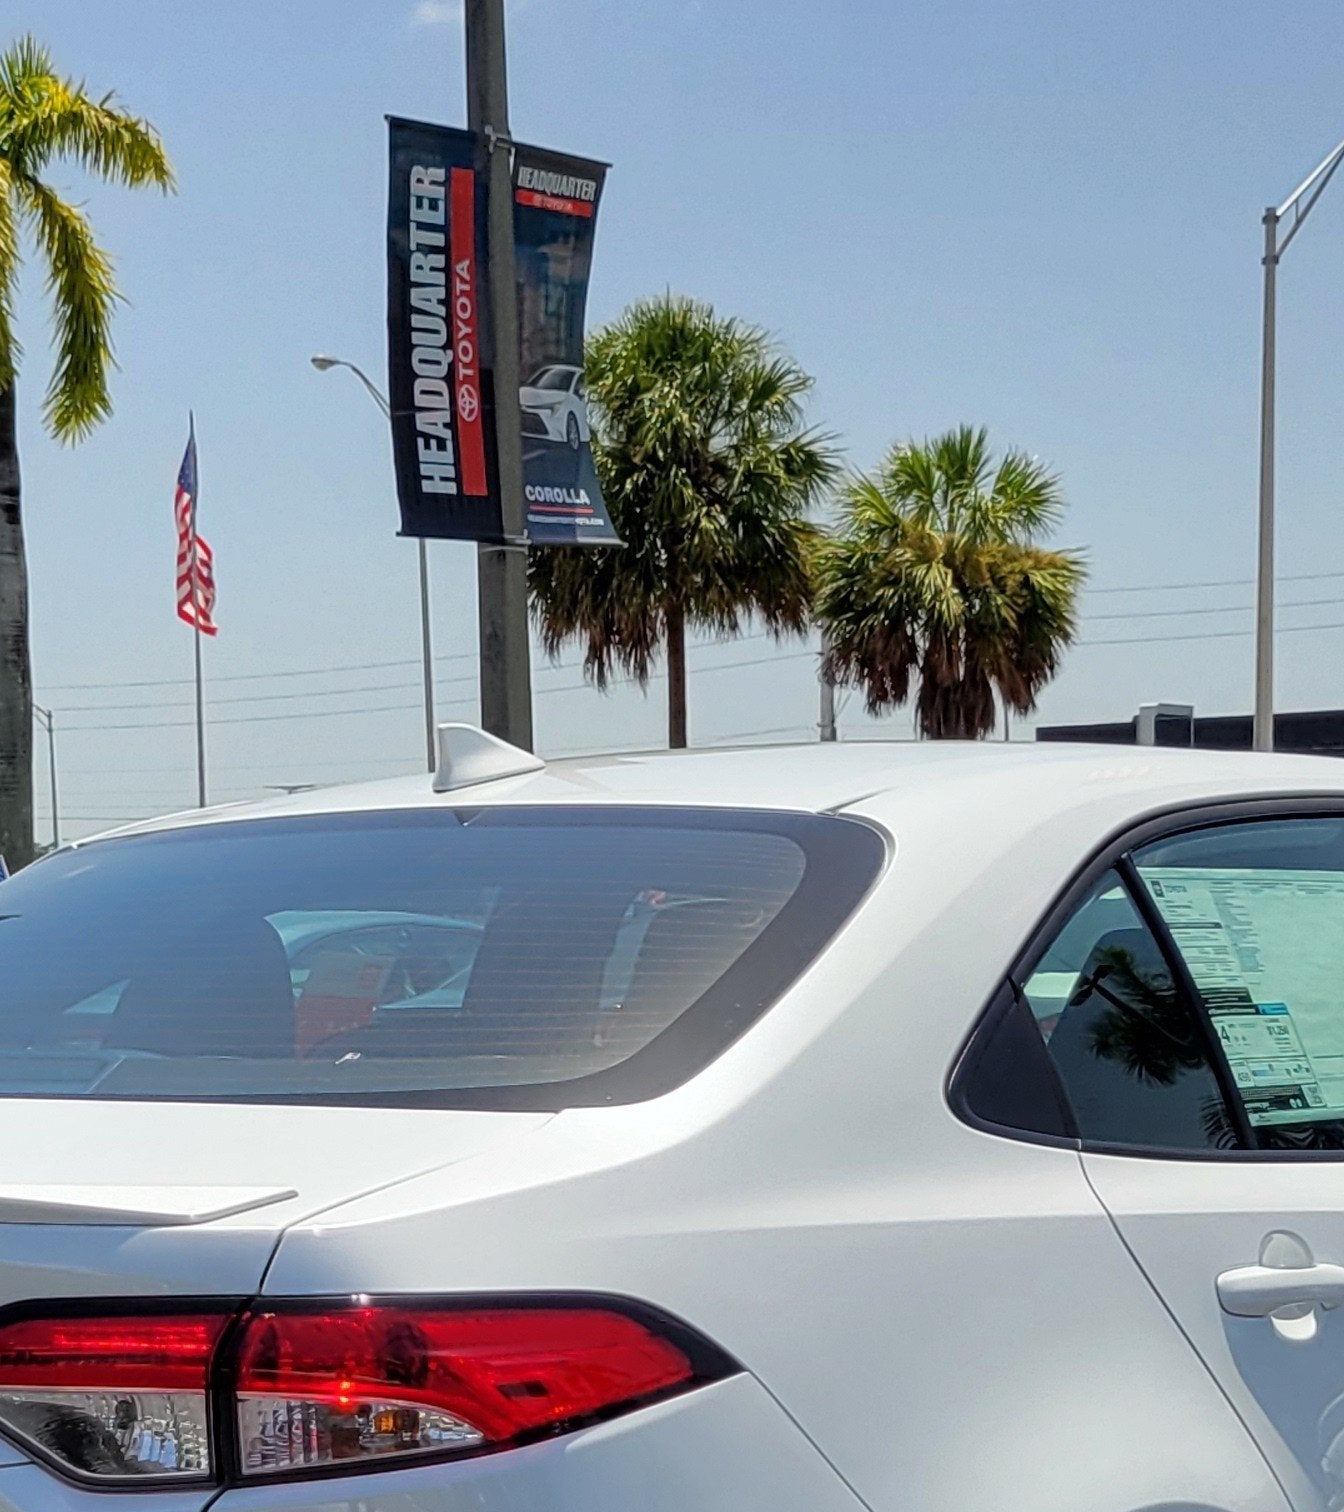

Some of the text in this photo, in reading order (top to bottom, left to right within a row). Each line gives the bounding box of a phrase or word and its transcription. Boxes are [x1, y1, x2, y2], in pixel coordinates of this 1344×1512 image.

[517, 166, 596, 202] HEADQUARTER
[409, 164, 458, 495] HEADQUARTER
[456, 259, 475, 386] TOYOTA
[524, 484, 591, 506] COROLLA
